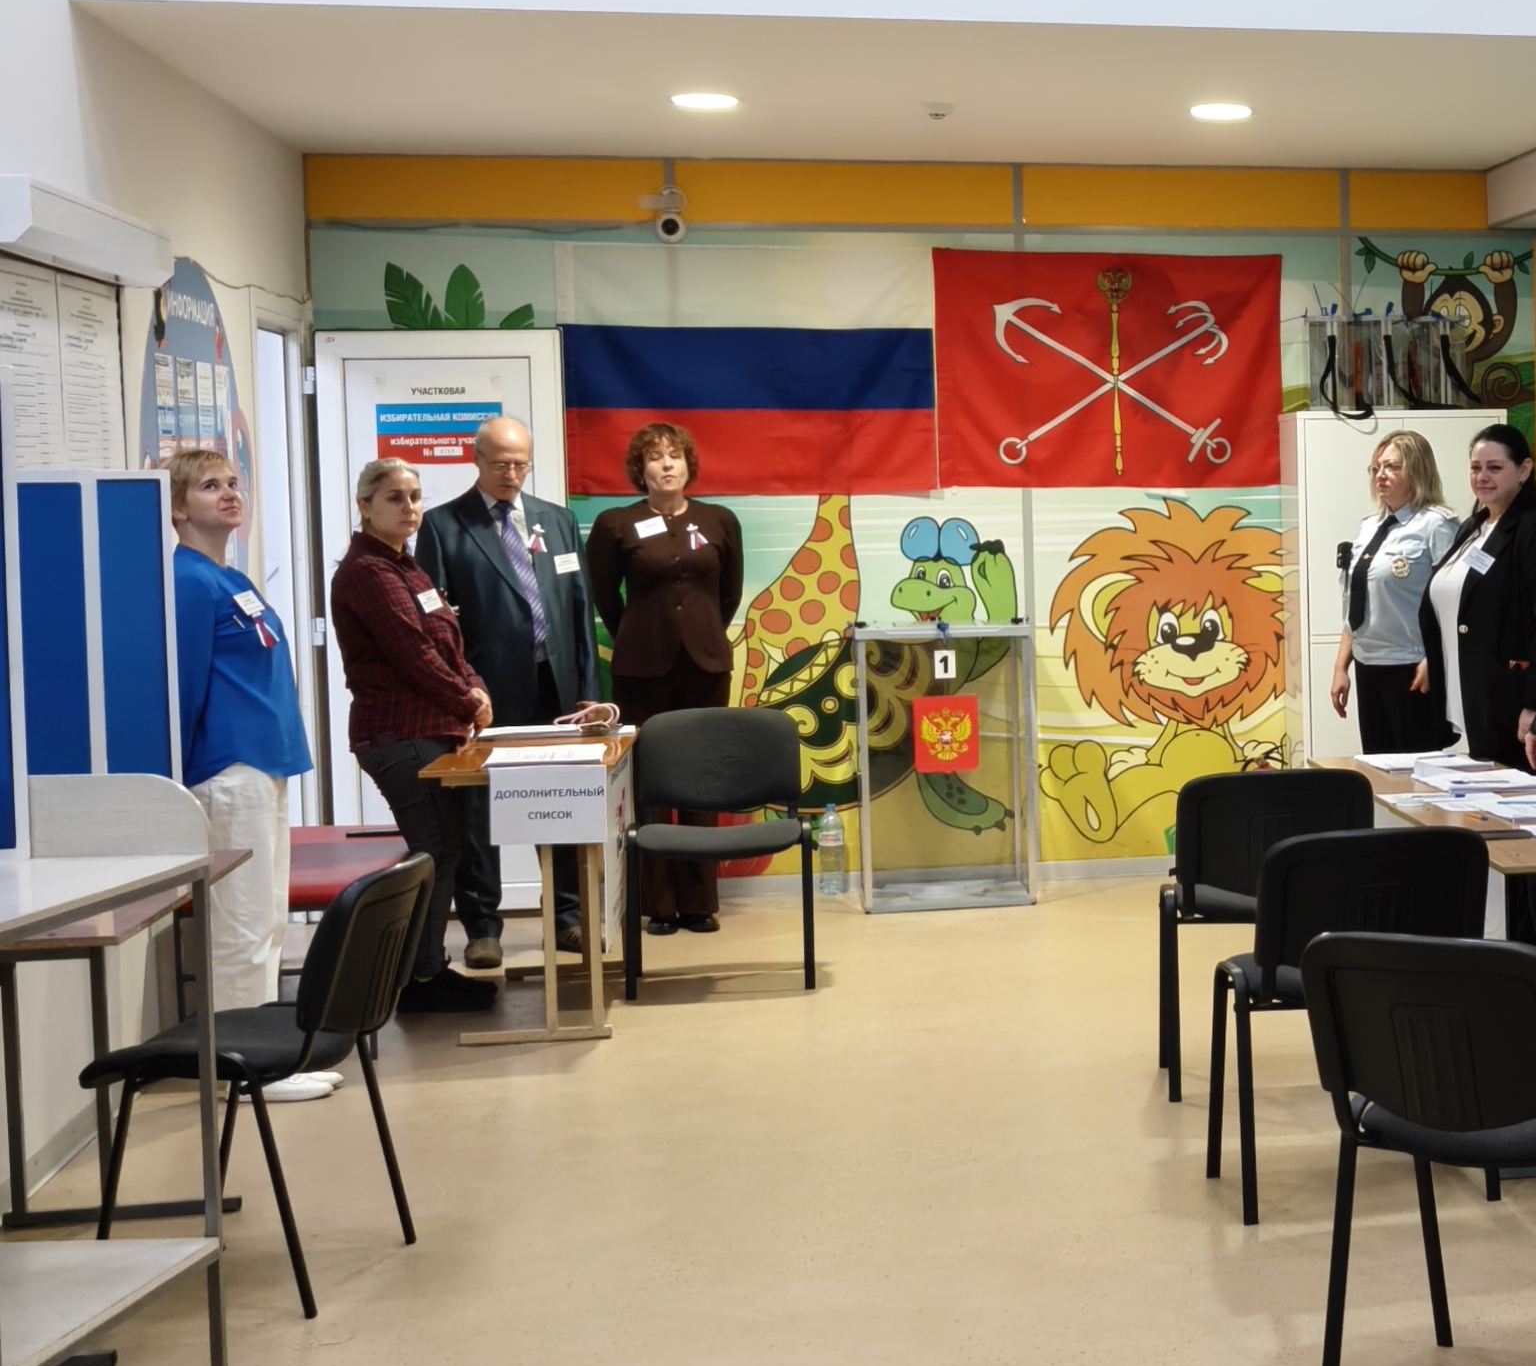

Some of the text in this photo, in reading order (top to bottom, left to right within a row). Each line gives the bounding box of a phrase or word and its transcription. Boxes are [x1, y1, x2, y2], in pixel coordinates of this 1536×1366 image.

[411, 387, 466, 396] УЧАСТКОВАЯ
[380, 413, 451, 422] ИЗБИРАТЕЛЬНАЯ
[391, 436, 476, 446] избирательного учас
[939, 654, 949, 674] 1
[494, 786, 604, 800] ДОПОЛНИТЕЛЬНЫЙ
[527, 810, 573, 820] СПИСОК
